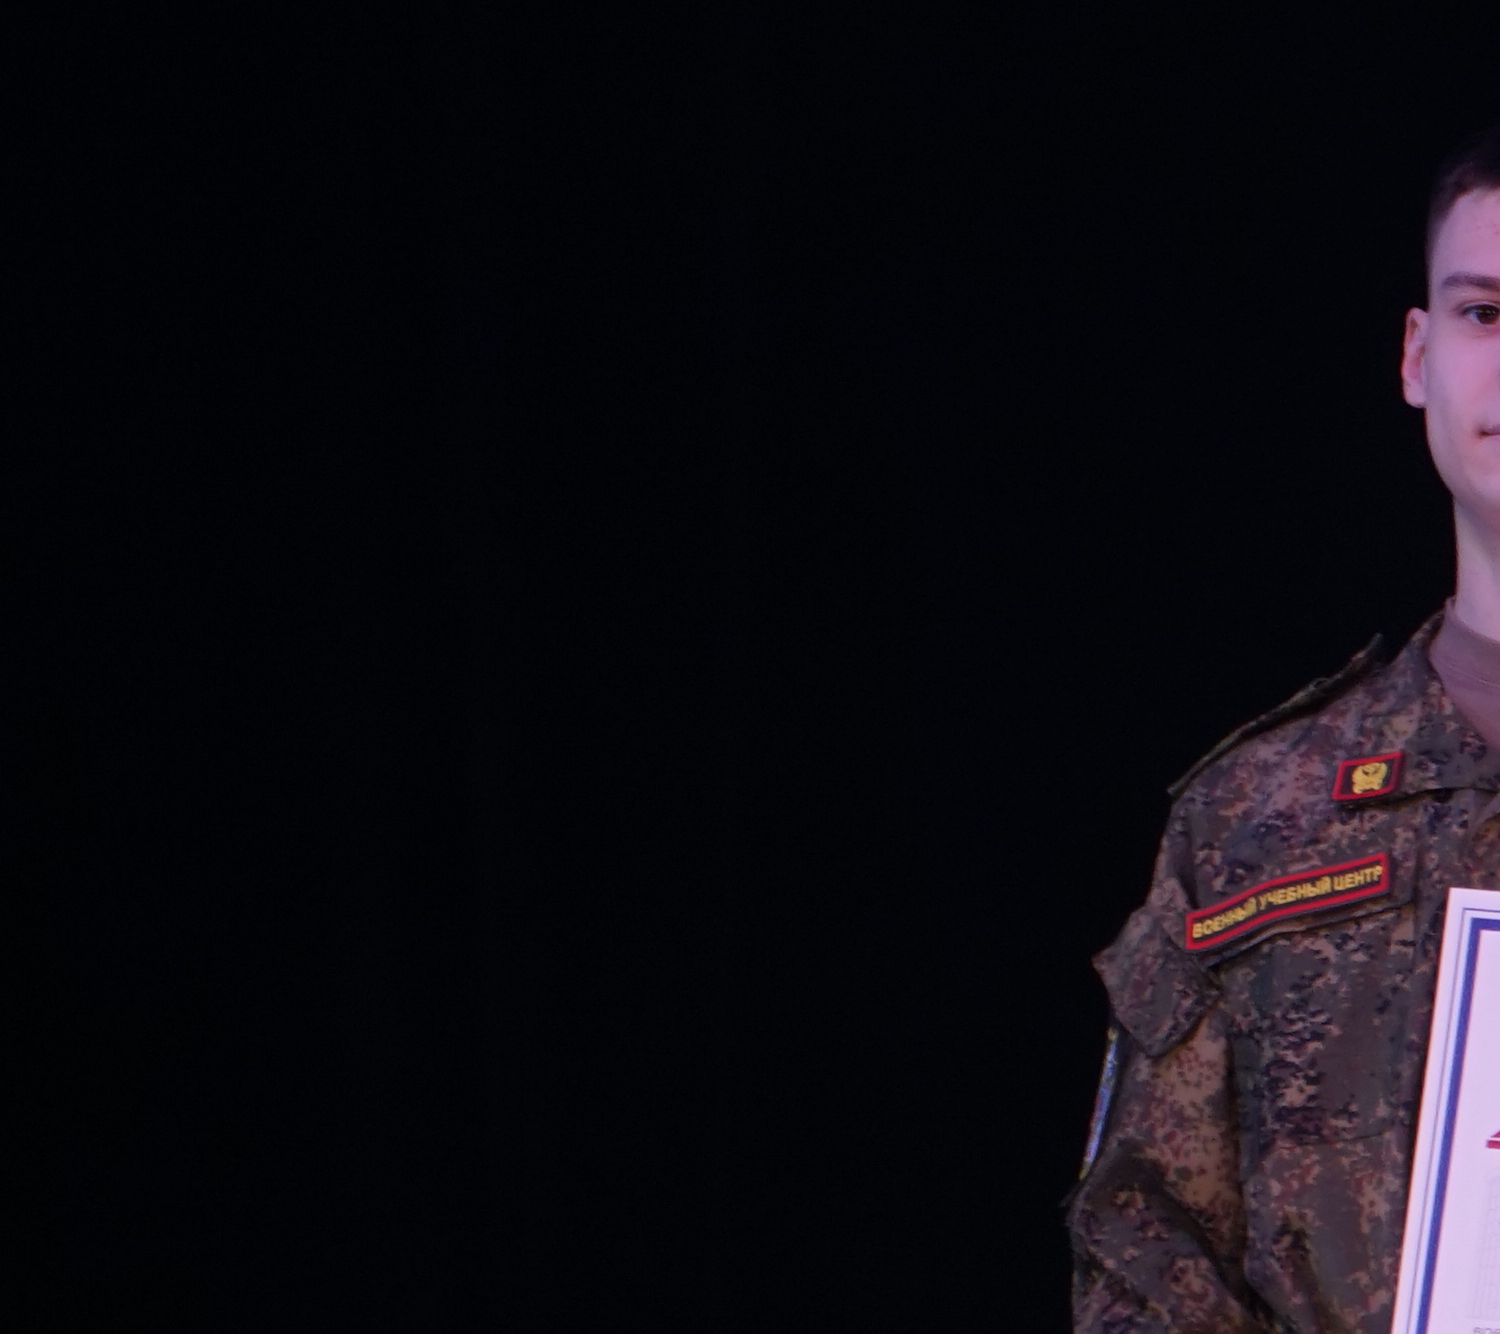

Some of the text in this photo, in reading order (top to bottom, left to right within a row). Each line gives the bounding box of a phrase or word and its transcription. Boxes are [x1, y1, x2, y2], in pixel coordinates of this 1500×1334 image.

[1192, 865, 1383, 939] ВОЕННЫЙ УЧЕБНЫЙ ЦЕНТР
